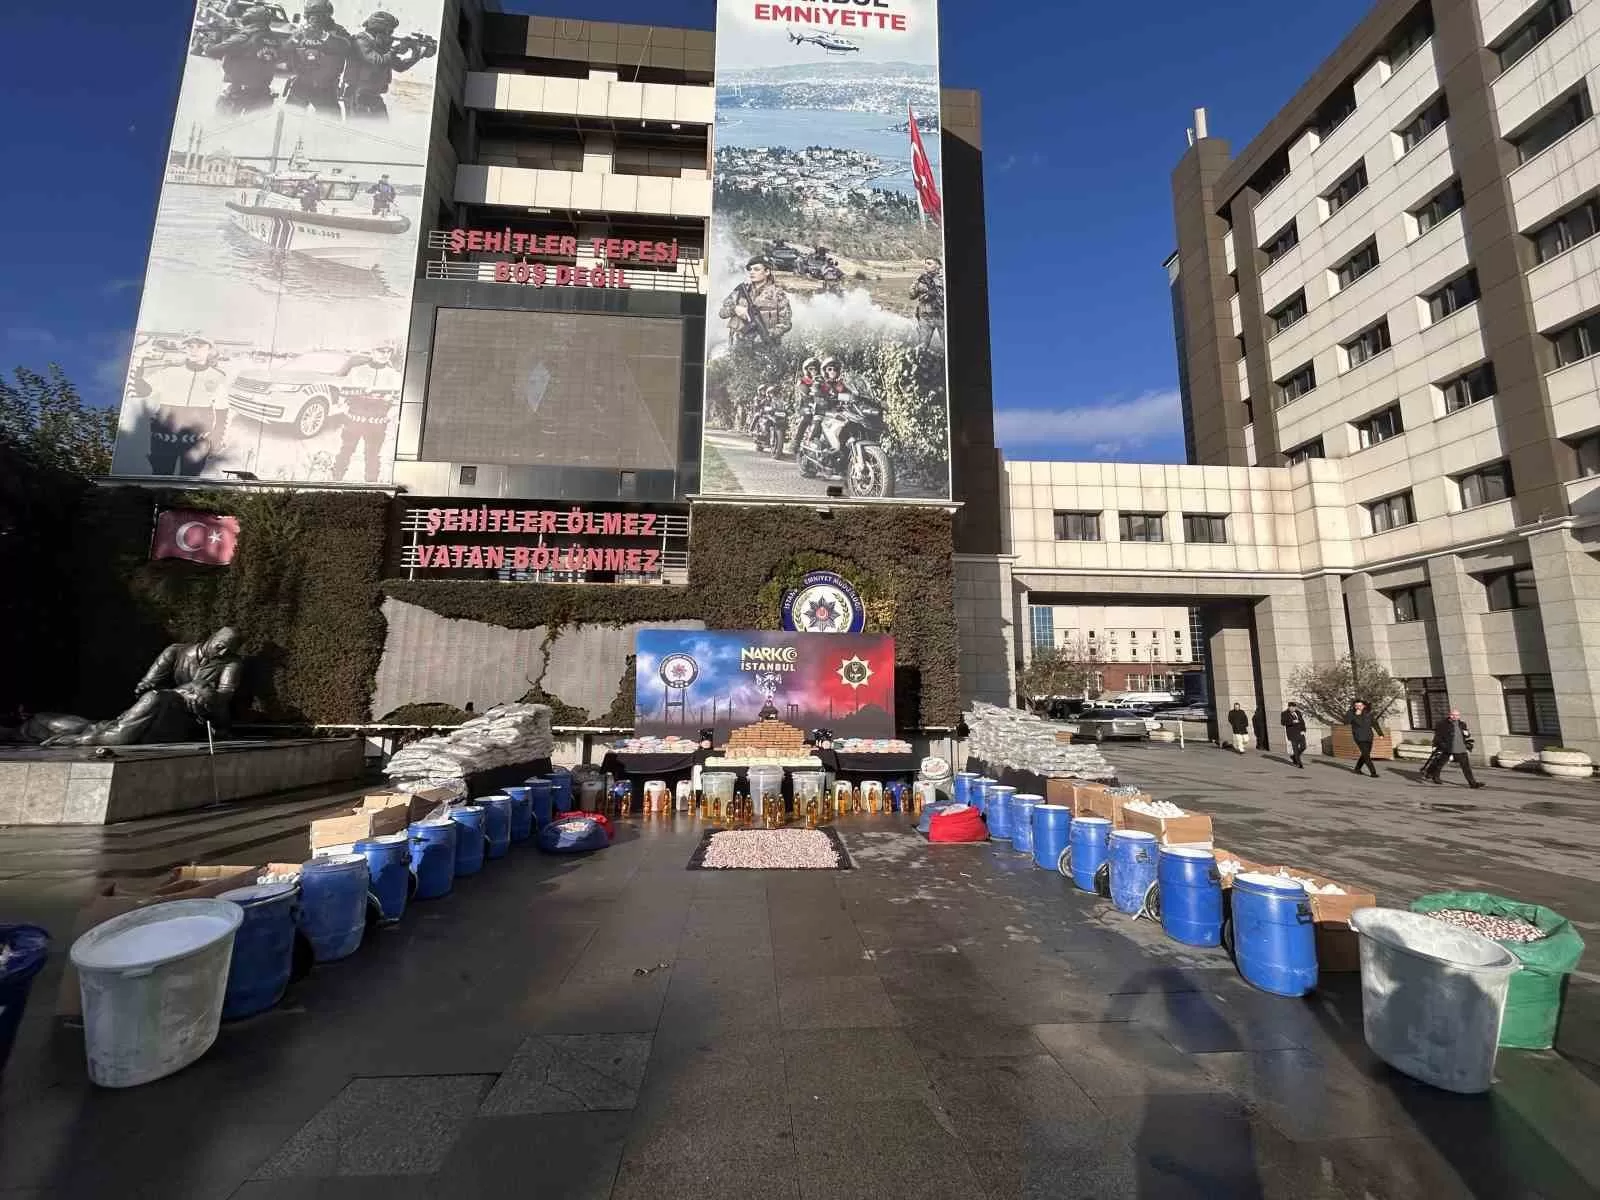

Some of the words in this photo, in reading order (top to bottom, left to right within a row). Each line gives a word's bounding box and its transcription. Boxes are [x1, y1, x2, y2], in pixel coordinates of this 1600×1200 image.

[450, 227, 576, 256] ŞEHİTLER
[591, 237, 678, 263] TEPESİ
[495, 260, 547, 288] BOŞ
[556, 262, 631, 288] DEĞİL
[427, 504, 556, 535] ŞEHİTLER
[567, 506, 657, 536] ÖLMEZ
[417, 544, 505, 569] VATAN
[513, 542, 661, 572] BÖLÜNMEZ
